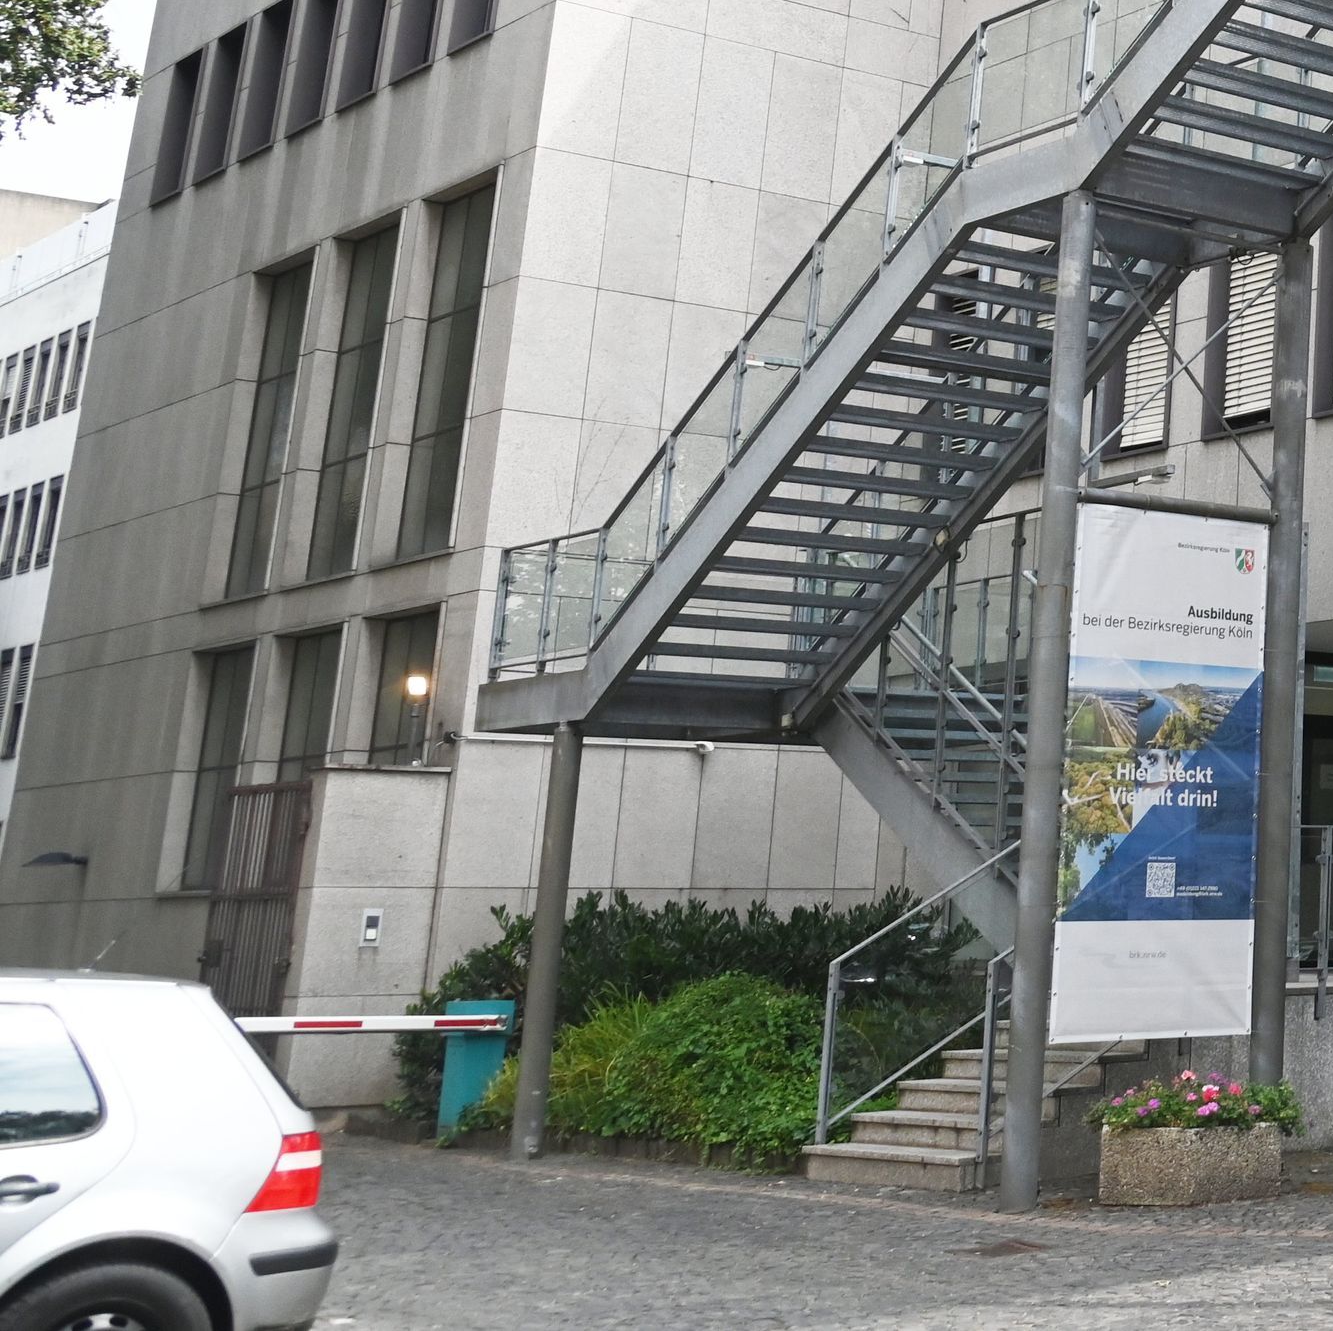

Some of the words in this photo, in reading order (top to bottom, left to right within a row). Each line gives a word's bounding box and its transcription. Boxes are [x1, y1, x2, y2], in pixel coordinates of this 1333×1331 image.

[1177, 542, 1219, 553] Bezirksregierung
[1187, 605, 1253, 625] Ausbildung
[1082, 613, 1102, 627] bei
[1104, 615, 1125, 628] der
[1128, 616, 1226, 639] Bezirksregierung
[1228, 625, 1253, 639] Köln
[1116, 762, 1153, 783] Hier
[1160, 764, 1214, 784] steckt
[1177, 788, 1218, 807] drin!
